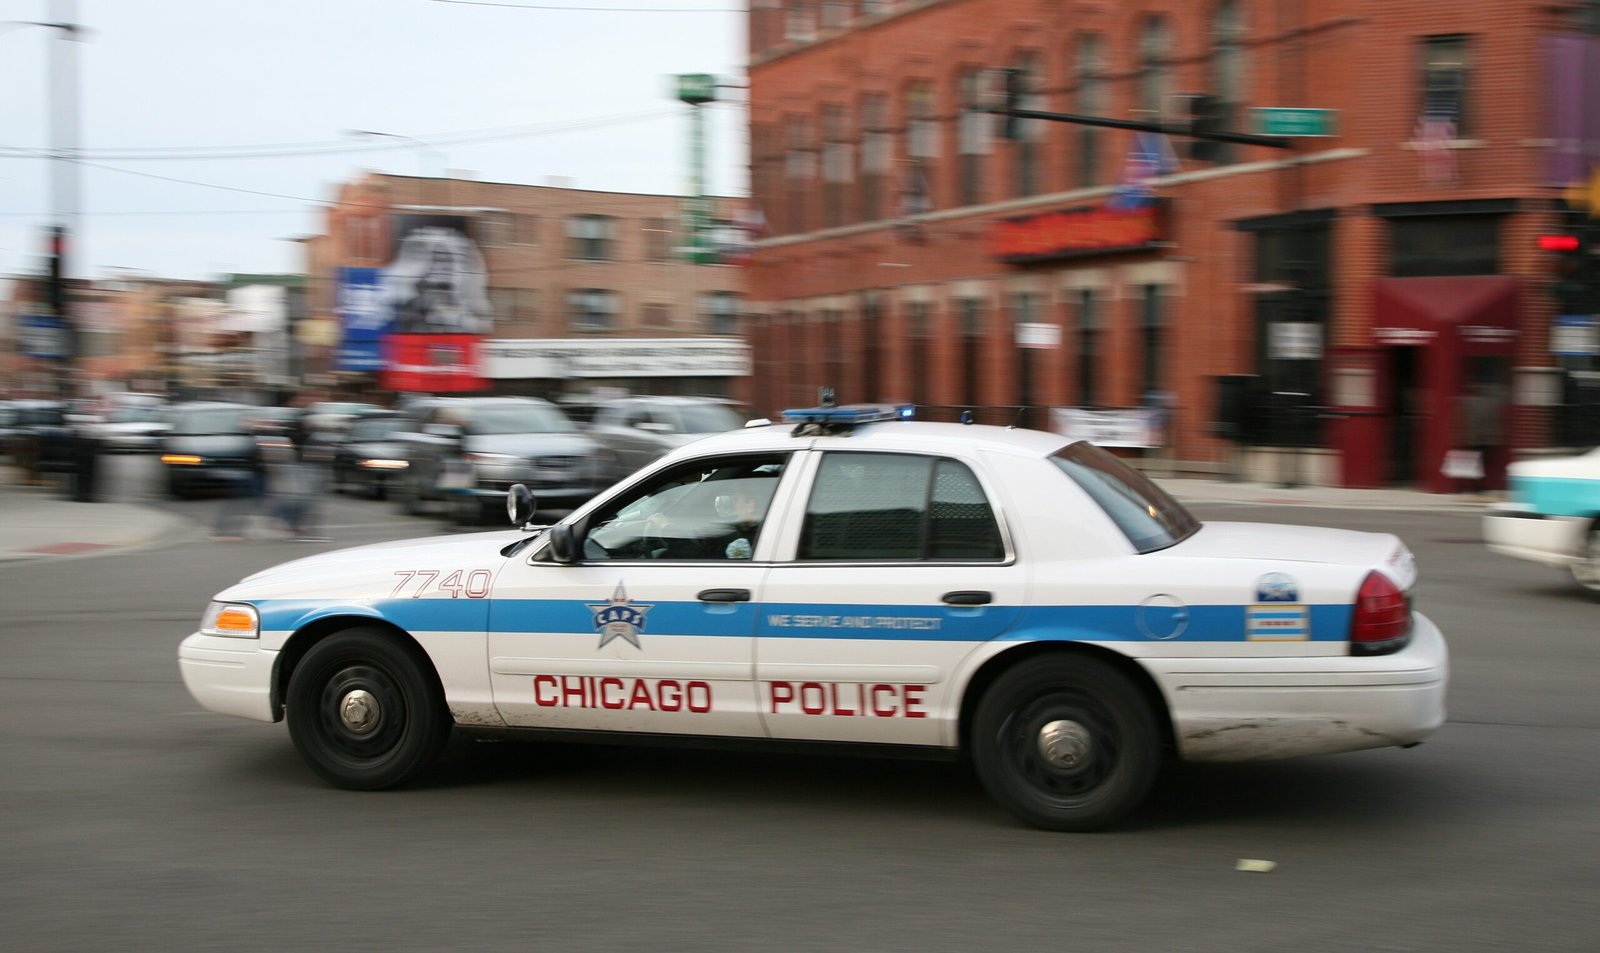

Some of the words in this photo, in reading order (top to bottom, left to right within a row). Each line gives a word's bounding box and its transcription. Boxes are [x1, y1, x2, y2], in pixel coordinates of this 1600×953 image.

[389, 569, 492, 599] 7740
[597, 610, 642, 624] CAPS
[767, 615, 792, 627] WE
[793, 615, 841, 628] SERVE
[841, 616, 873, 629] AND
[874, 617, 943, 630] PROTECT
[533, 674, 712, 714] CHICAGO
[769, 681, 928, 718] POLICE
